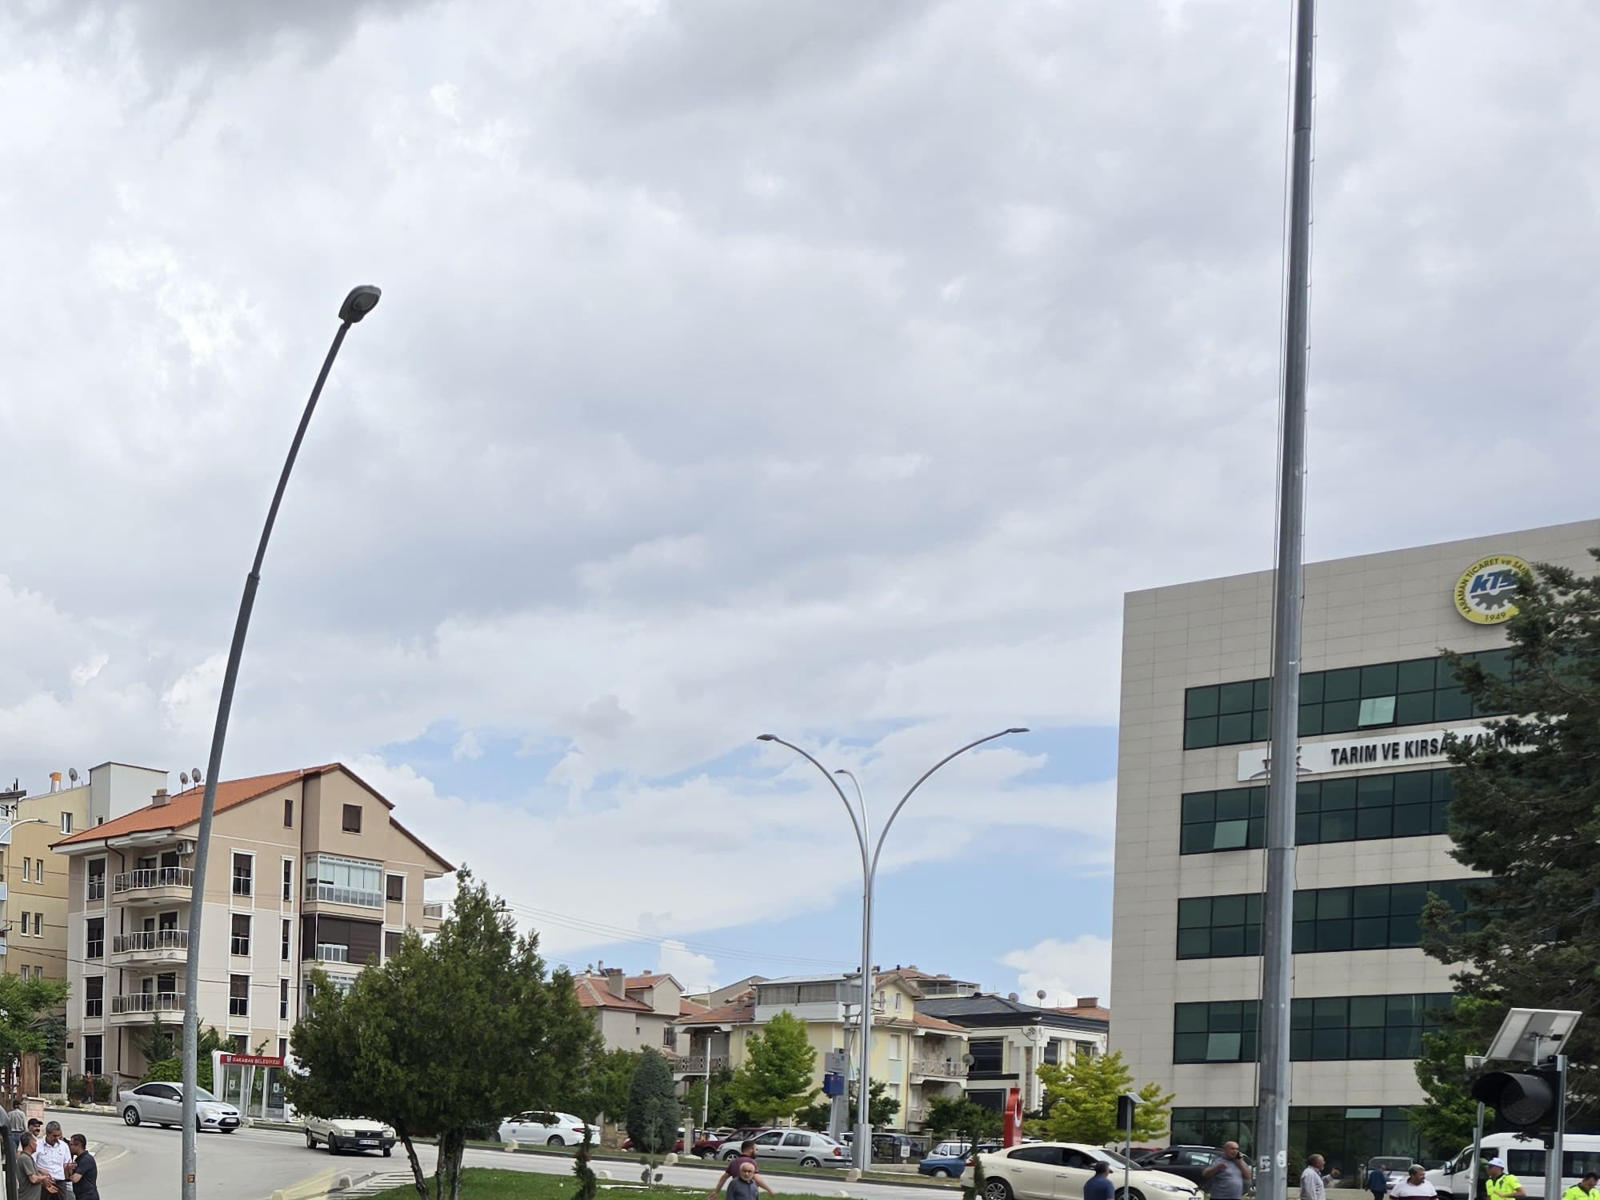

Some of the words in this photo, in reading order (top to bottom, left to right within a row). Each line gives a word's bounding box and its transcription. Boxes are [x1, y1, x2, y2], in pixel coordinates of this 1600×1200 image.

[1485, 612, 1506, 621] 1949
[1331, 744, 1377, 766] TARIM
[1382, 742, 1399, 760] VE
[1405, 737, 1449, 759] KIRSA
